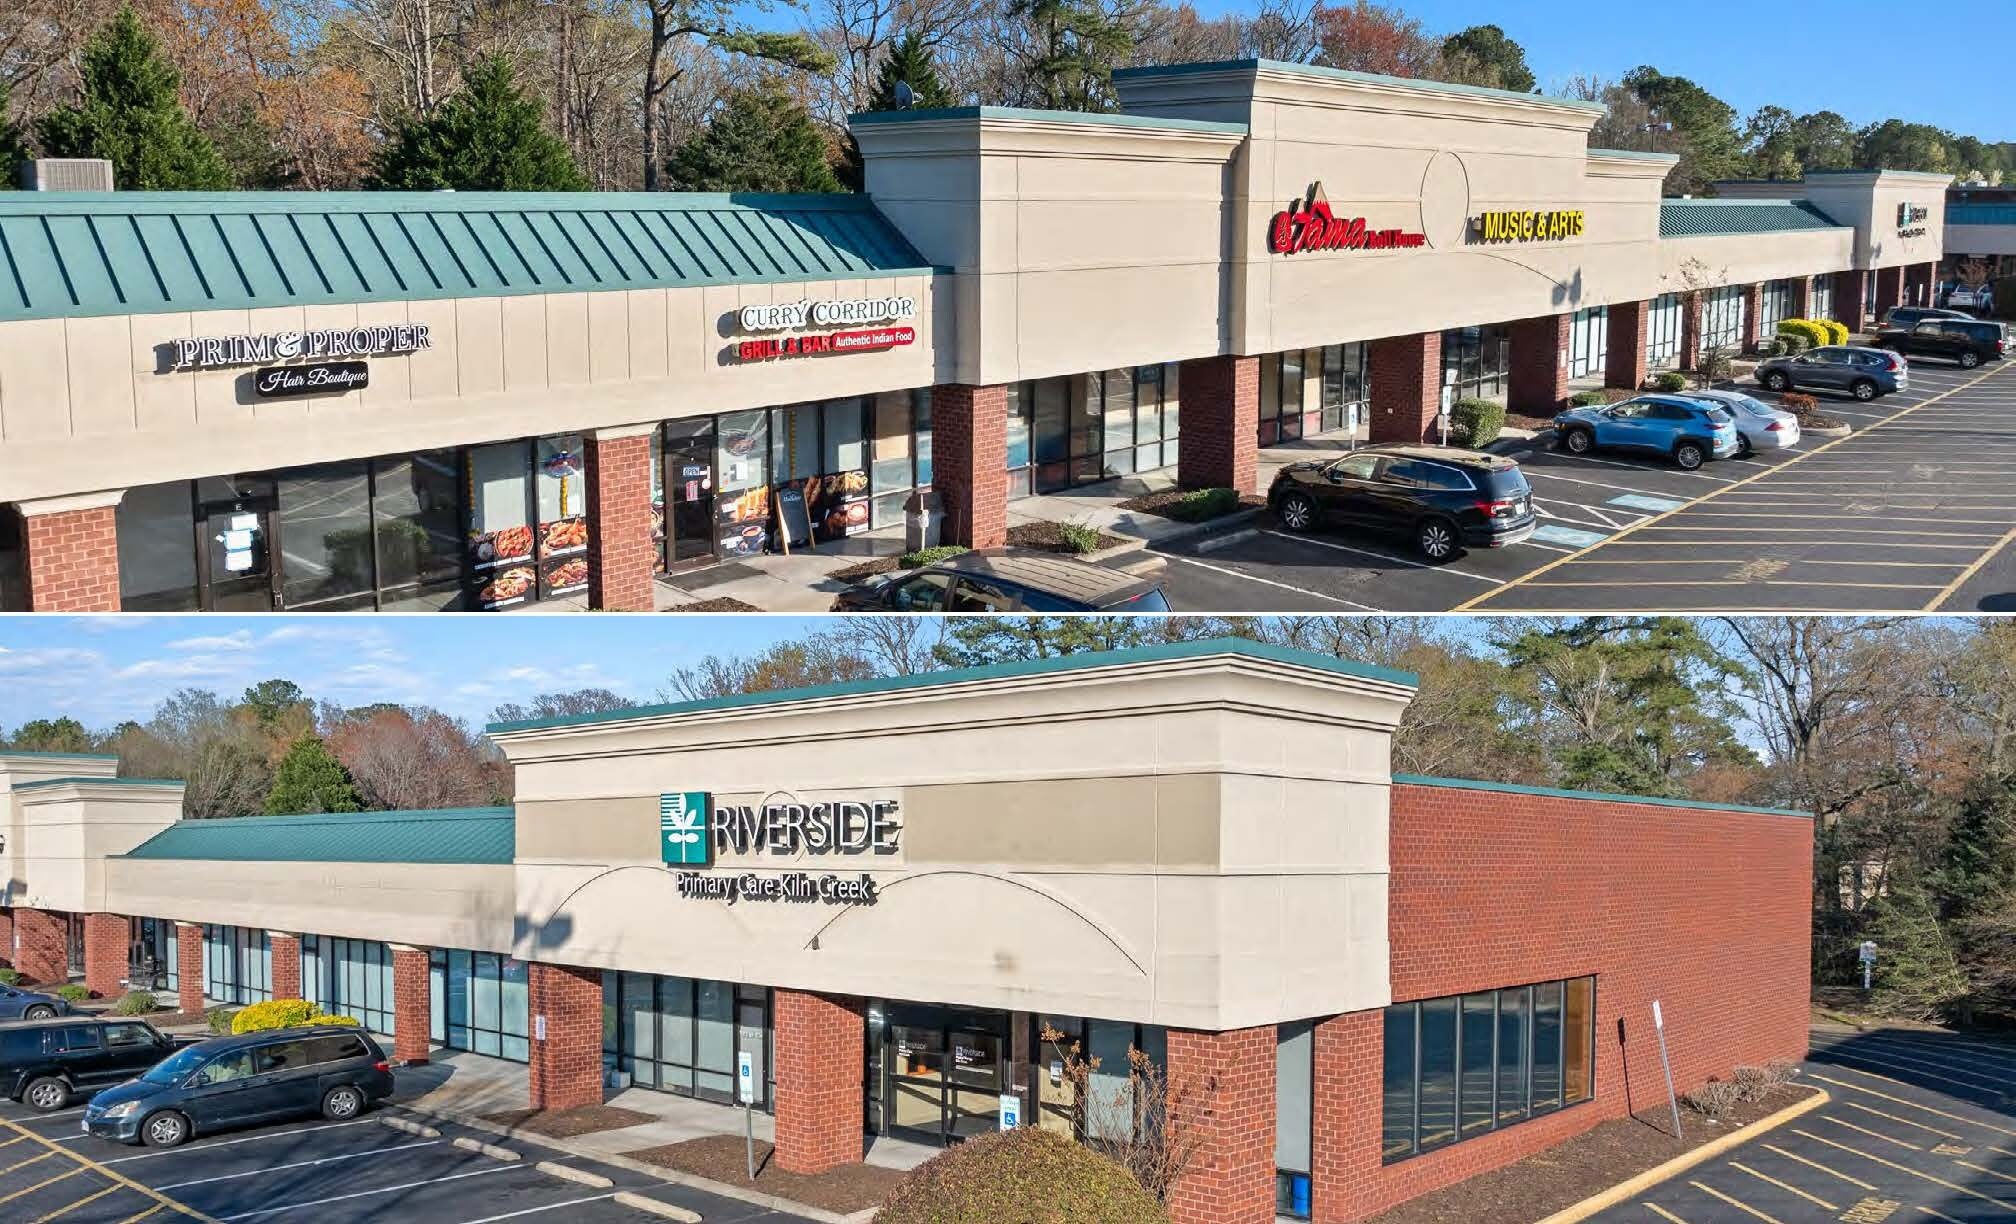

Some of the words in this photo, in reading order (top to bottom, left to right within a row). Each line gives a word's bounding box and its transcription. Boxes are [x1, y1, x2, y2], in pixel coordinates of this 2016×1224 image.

[1484, 211, 1534, 239] MUSIC
[1536, 212, 1546, 237] &
[1549, 210, 1584, 237] ARTS
[743, 303, 806, 327] CURRY
[815, 299, 913, 321] CORRIDOR
[307, 323, 432, 357] PROPER
[741, 341, 784, 359] GRILL
[786, 338, 798, 355] &
[802, 336, 832, 353] BAR
[835, 336, 871, 348] Authentic
[872, 333, 894, 345] Indian
[895, 330, 913, 342] Food
[260, 370, 305, 392] Hair
[307, 367, 368, 387] Boutique
[683, 466, 699, 476] OPEN
[714, 800, 897, 848] RIVERSIDE
[675, 872, 732, 898] Primary
[737, 873, 774, 895] Care
[779, 874, 811, 897] Kiln
[818, 875, 870, 899] Creek
